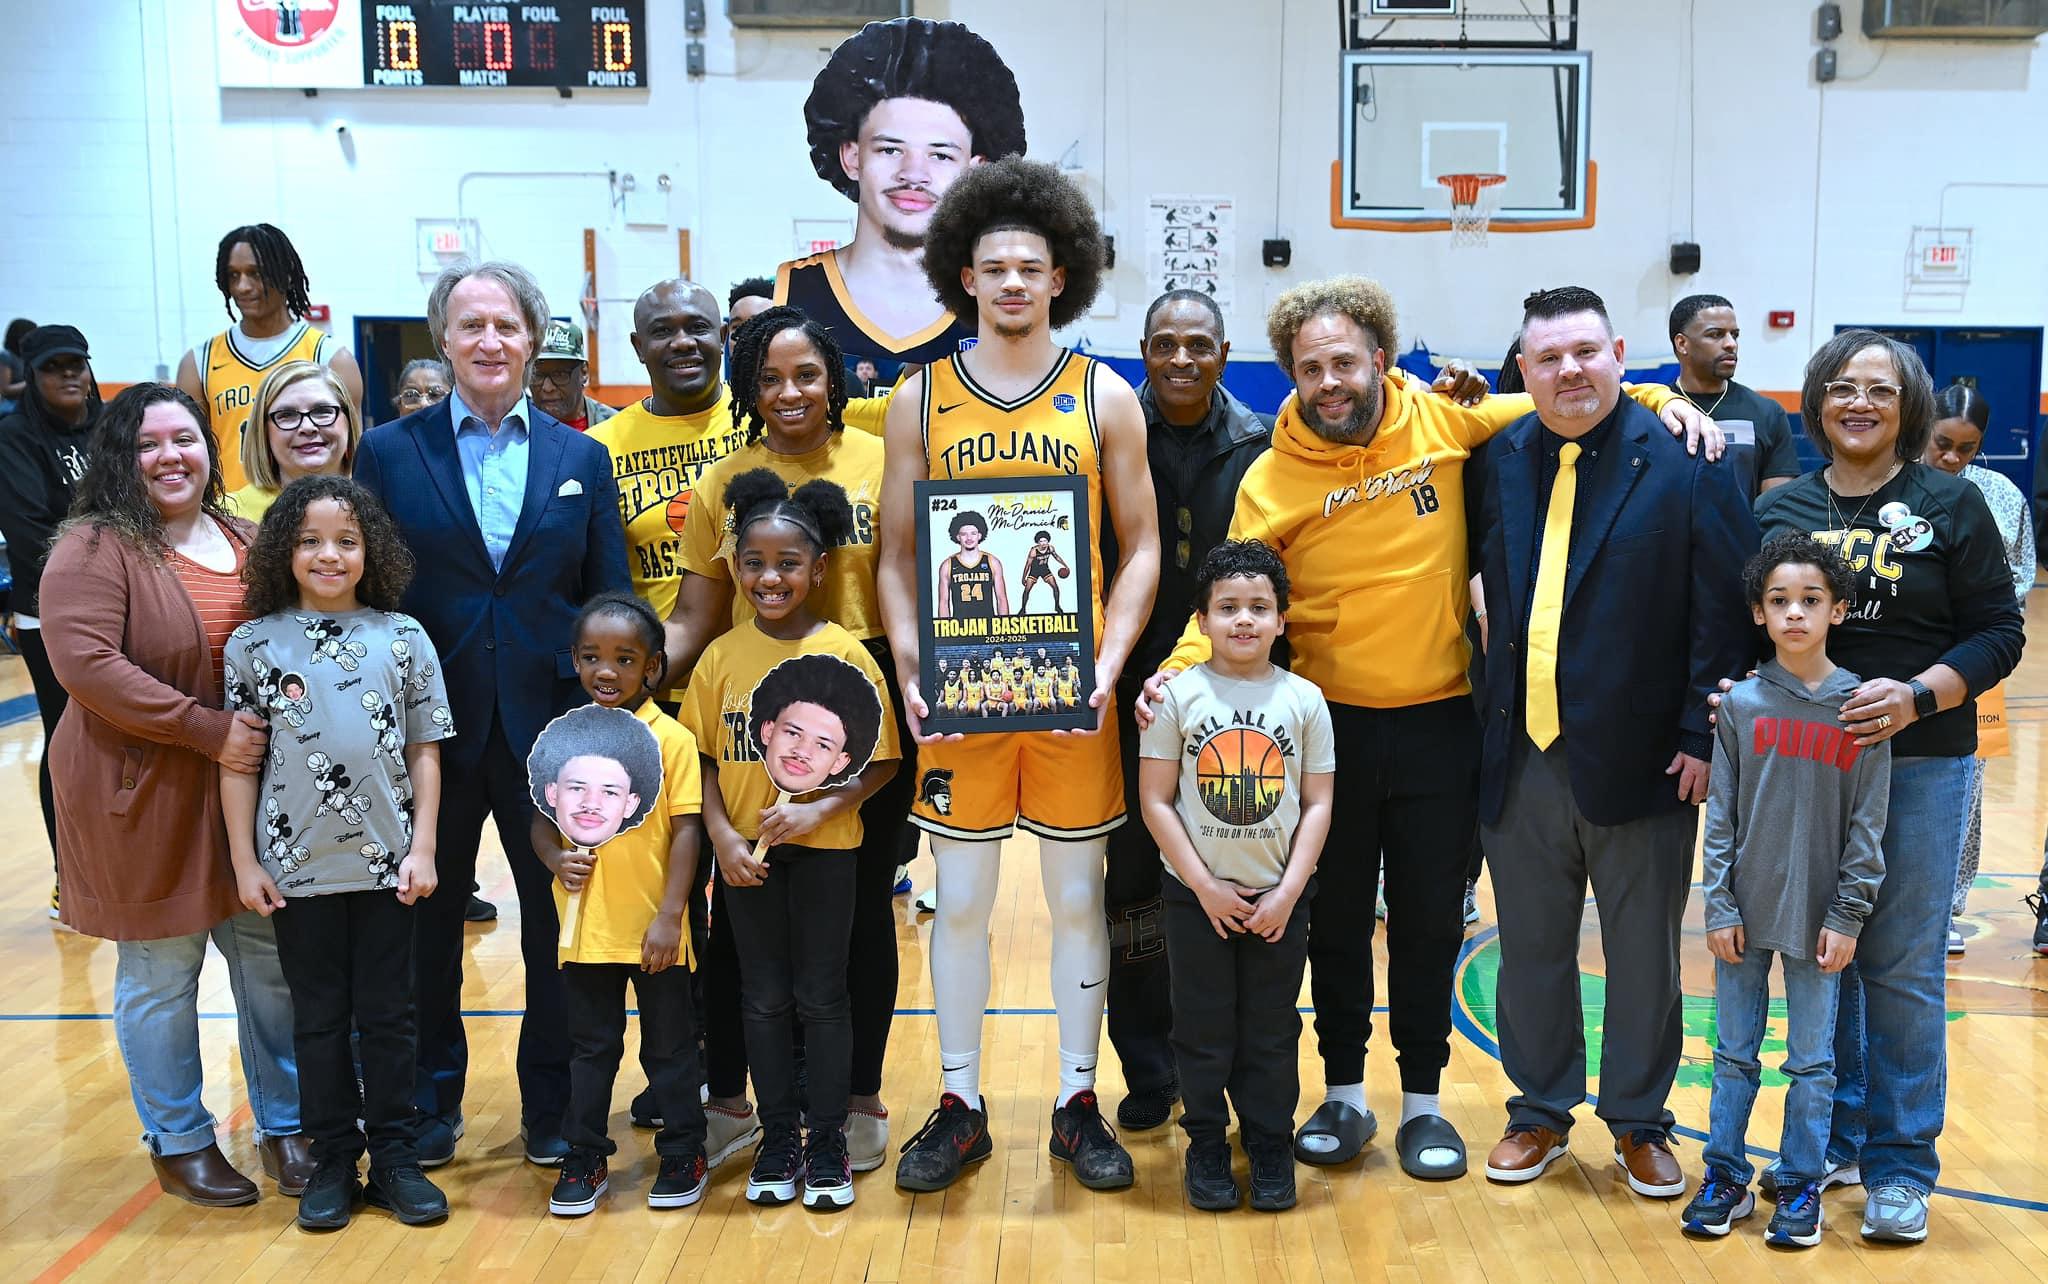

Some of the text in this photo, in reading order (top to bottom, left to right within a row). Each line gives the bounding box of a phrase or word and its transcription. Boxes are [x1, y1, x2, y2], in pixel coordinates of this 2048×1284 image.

[376, 5, 416, 21] FOUL
[453, 6, 508, 22] PLAYER
[521, 6, 560, 22] FOUL
[591, 7, 629, 22] FOUL
[484, 22, 513, 70] 0
[373, 69, 424, 85] POINTS
[459, 70, 508, 85] MATCH
[587, 70, 637, 86] POINTS
[215, 385, 256, 416] TRO
[615, 437, 717, 476] FAYETTEVILLE
[940, 431, 1079, 480] TROJANS
[614, 459, 714, 528] TROJ
[1410, 484, 1440, 516] 18
[931, 498, 958, 512] #24
[990, 514, 1056, 532] McCormick
[952, 572, 990, 583] TROJANS
[960, 583, 984, 602] 24
[933, 614, 1080, 638] TROJAN BASKETBALL
[984, 634, 1028, 644] 2024-2025
[1186, 709, 1295, 758] BALL ALL DAY
[1753, 717, 1863, 773] PUMA
[1215, 827, 1230, 839] YOU
[1231, 828, 1242, 840] ON
[1243, 828, 1257, 840] THE
